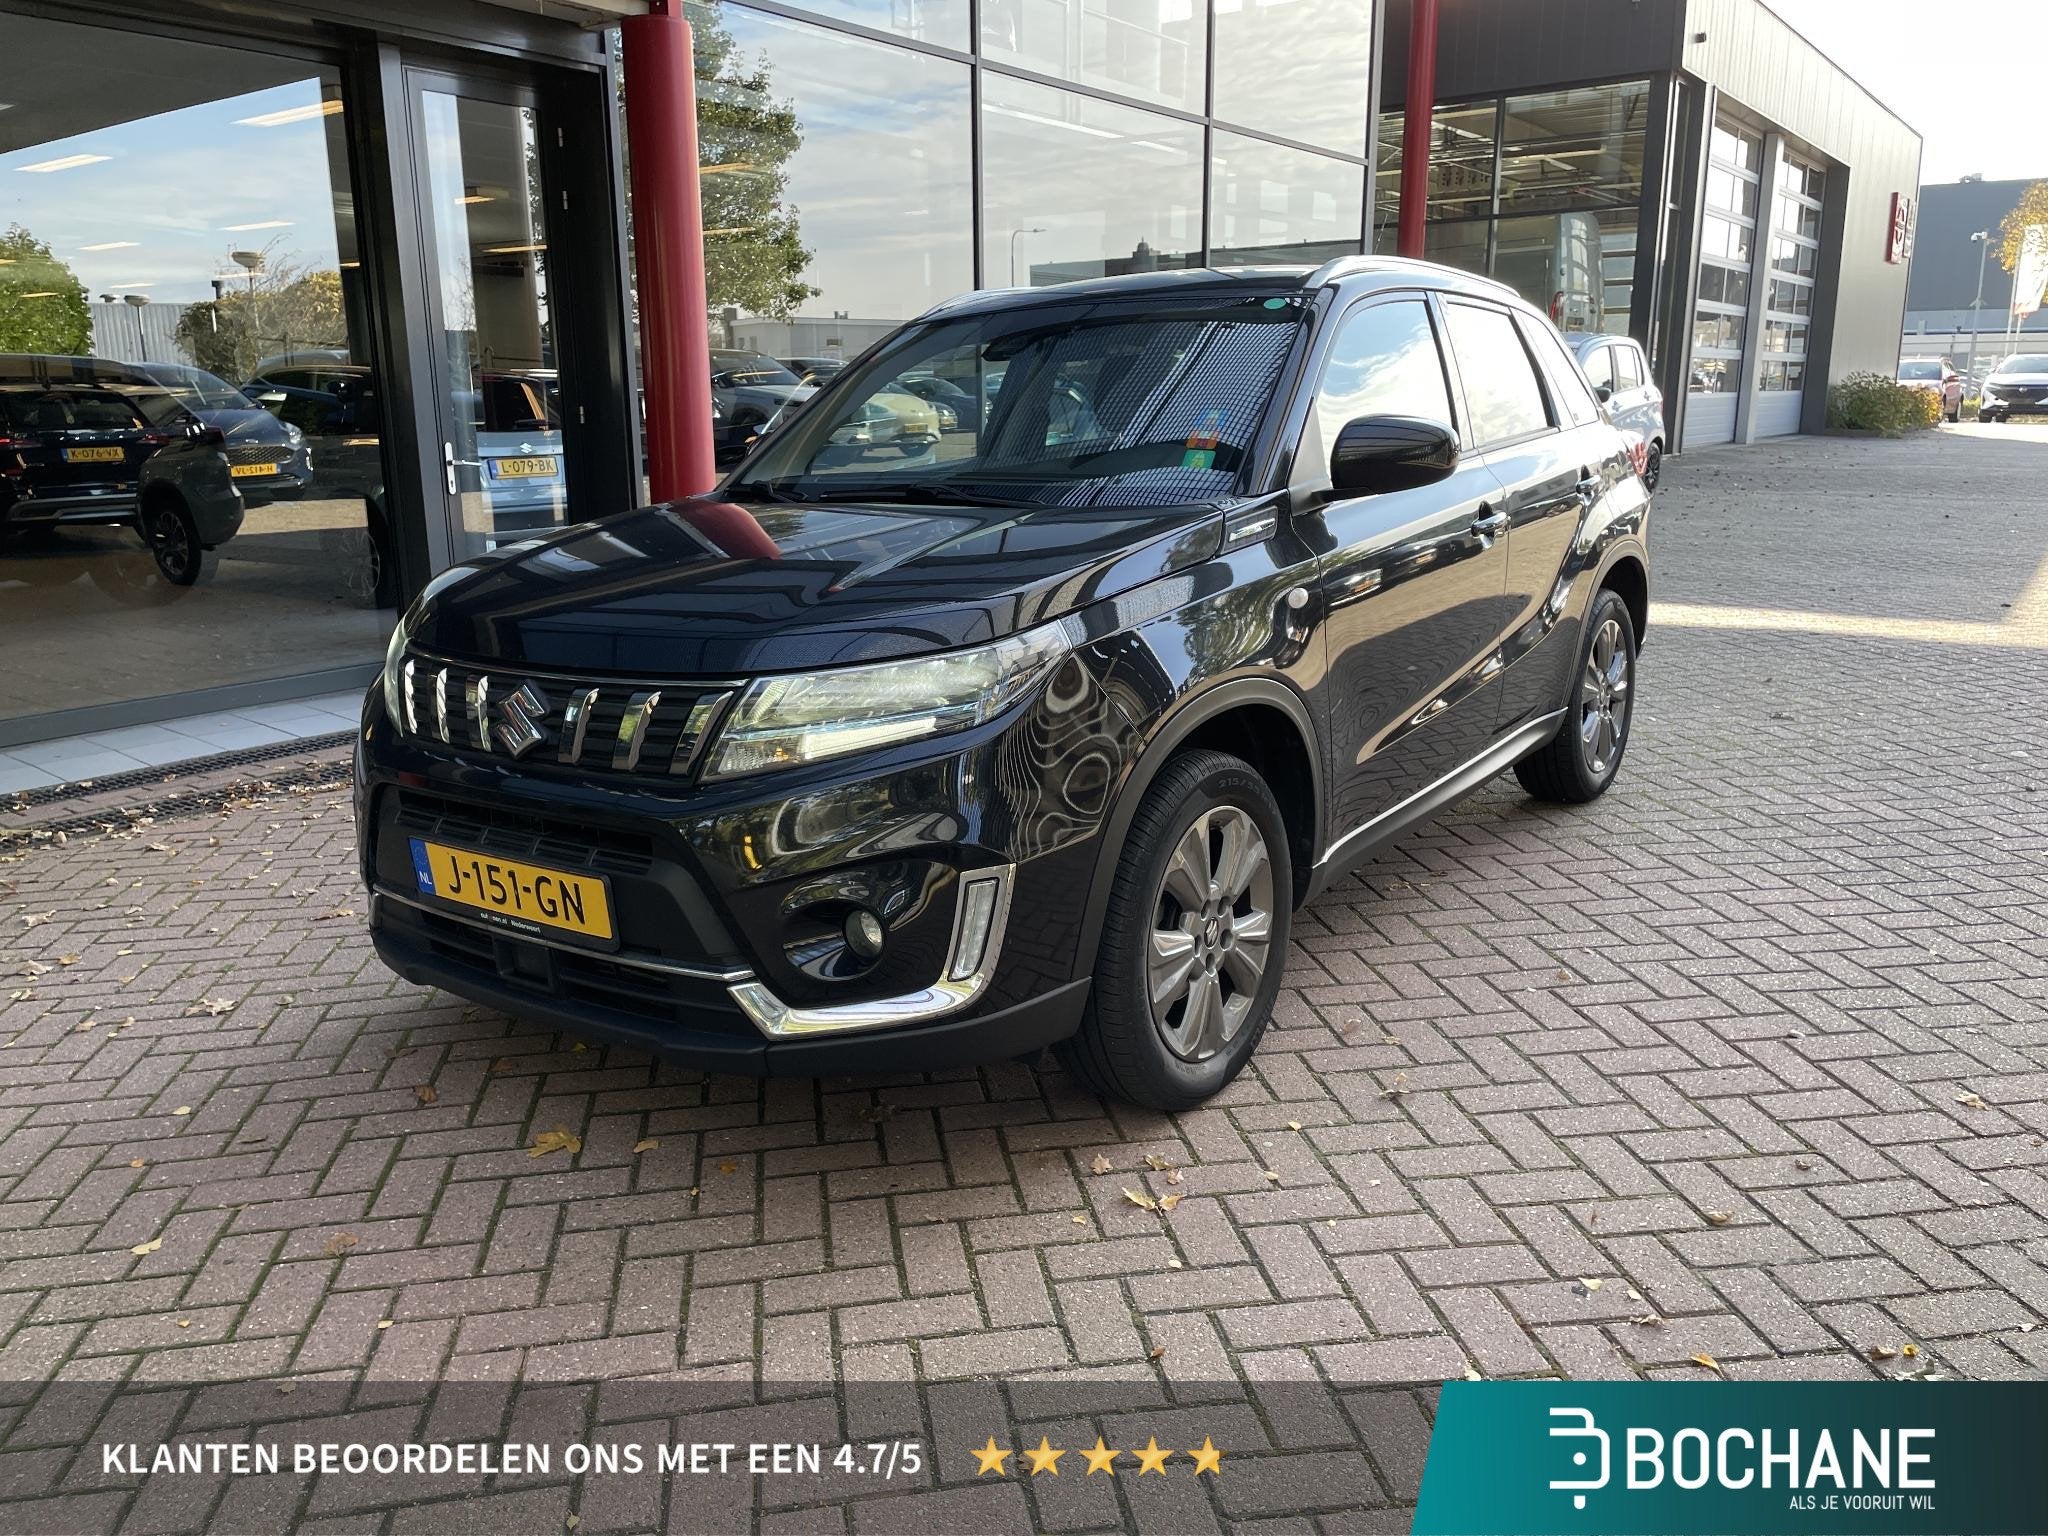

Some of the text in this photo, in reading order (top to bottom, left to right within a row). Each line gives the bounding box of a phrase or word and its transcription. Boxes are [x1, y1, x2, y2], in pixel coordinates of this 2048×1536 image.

[501, 460, 554, 473] L-079-BK
[418, 855, 586, 925] NL J-151-GN
